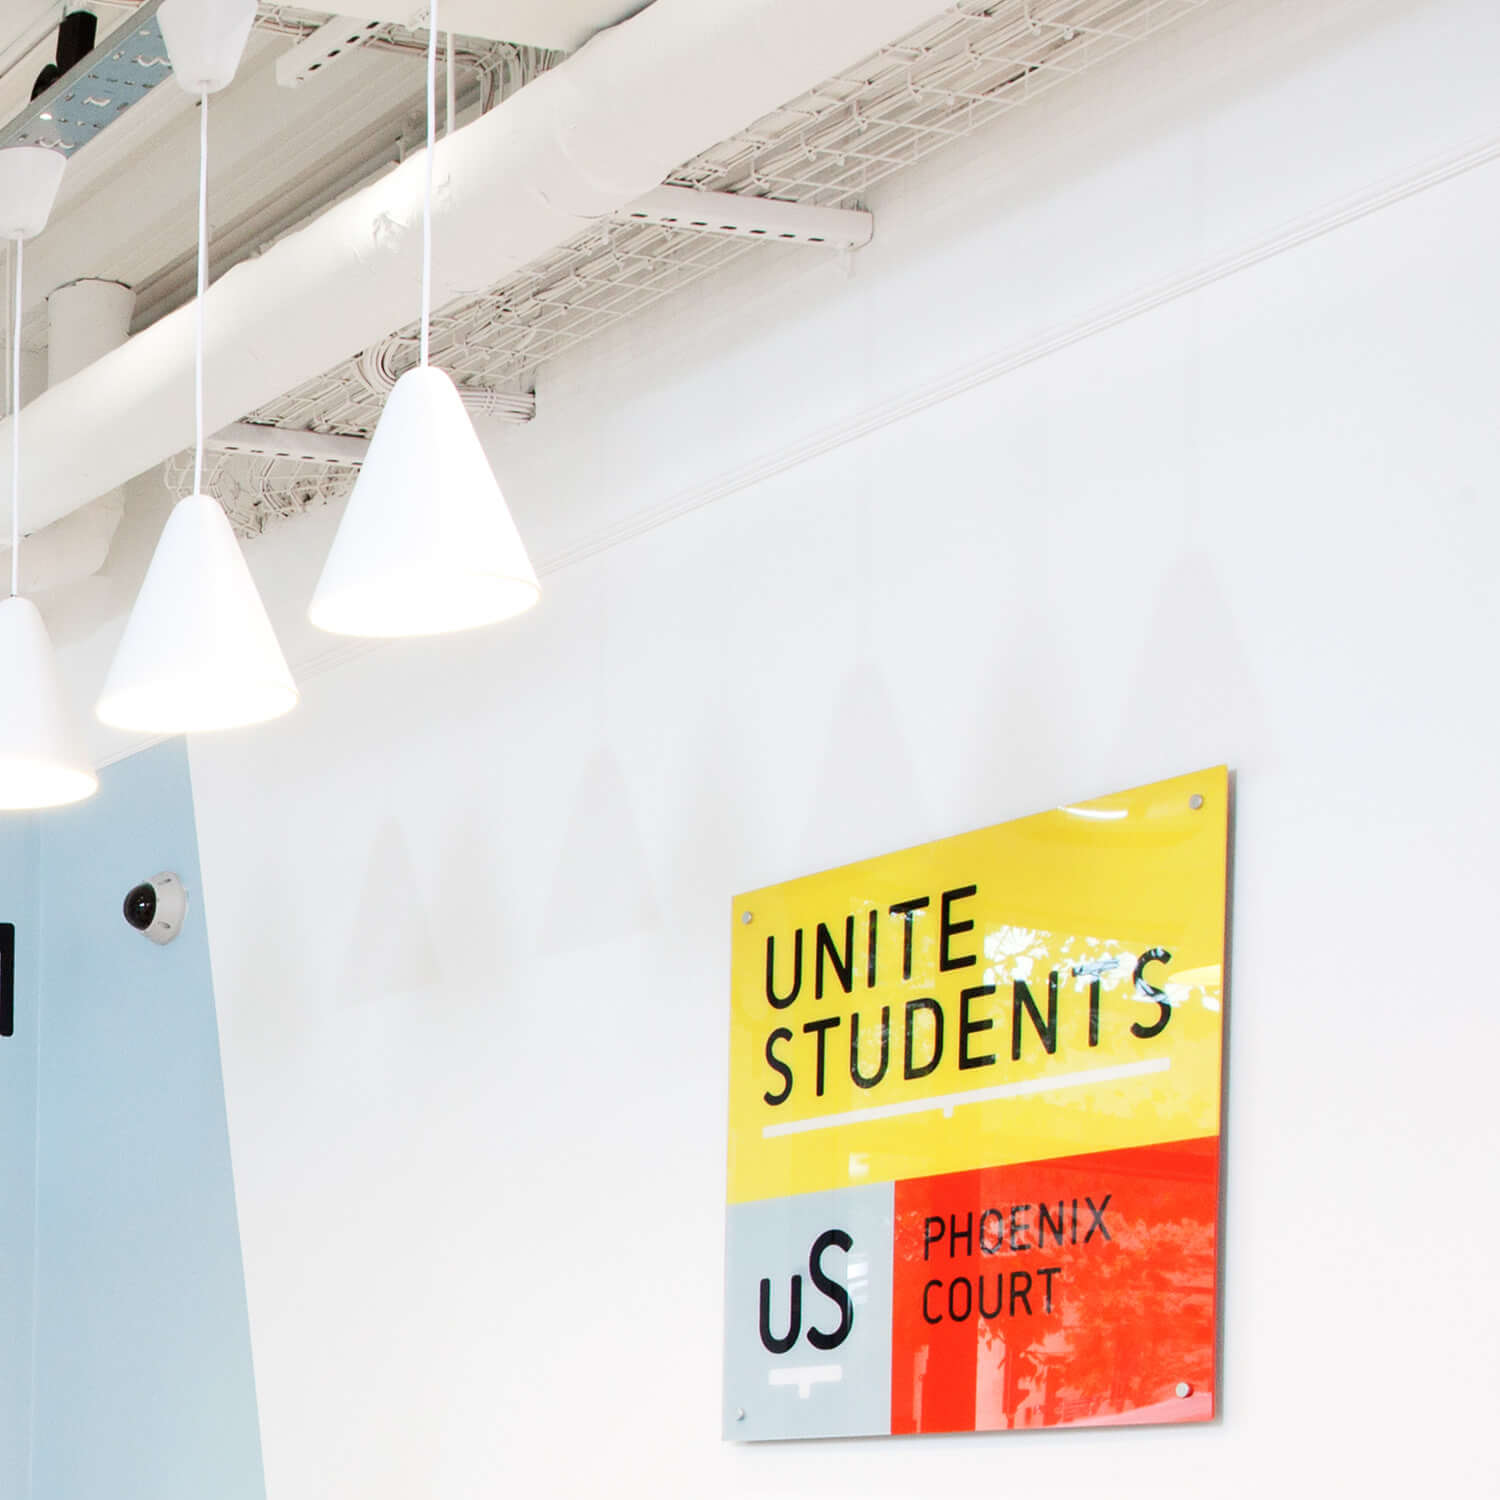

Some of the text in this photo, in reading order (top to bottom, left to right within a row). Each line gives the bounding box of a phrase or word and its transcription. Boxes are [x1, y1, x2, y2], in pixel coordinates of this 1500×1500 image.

[765, 884, 977, 1010] UNITE
[763, 947, 1173, 1106] STUDENTS
[923, 1194, 1113, 1262] PHOENIX
[922, 1268, 1062, 1326] COURT
